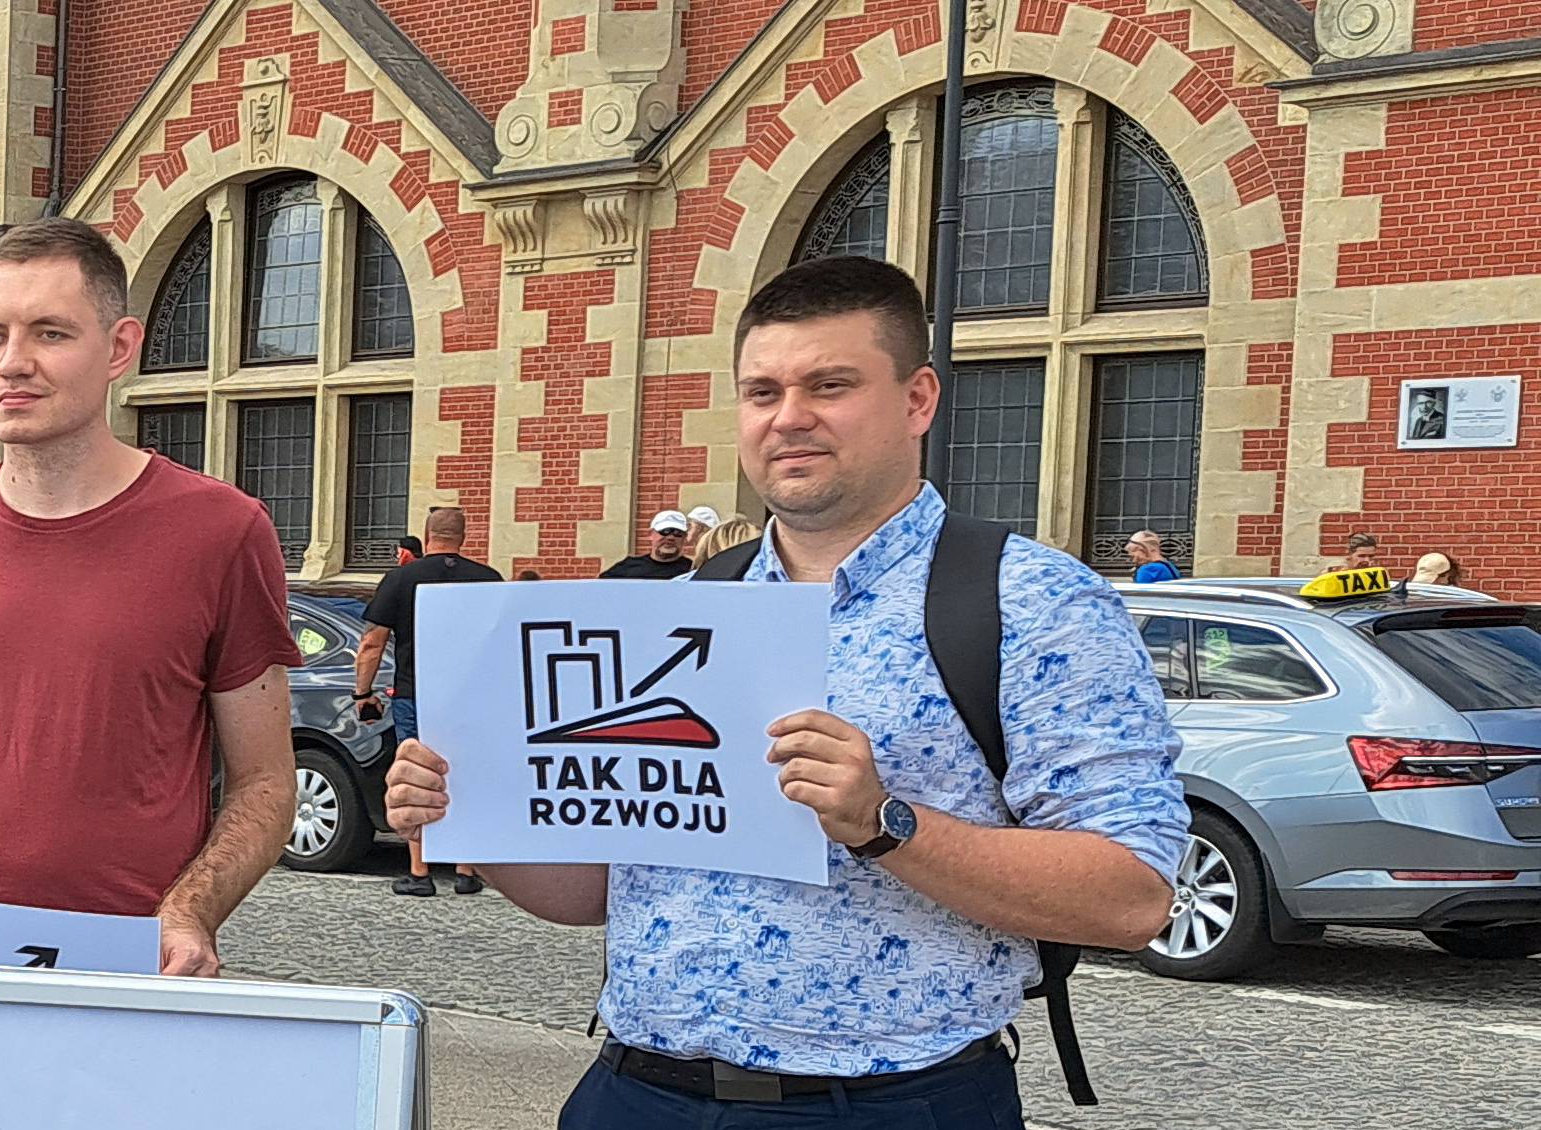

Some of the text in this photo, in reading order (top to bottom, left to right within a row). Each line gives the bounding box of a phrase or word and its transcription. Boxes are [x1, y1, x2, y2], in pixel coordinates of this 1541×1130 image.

[1336, 570, 1389, 593] TAXI
[528, 756, 725, 798] TAK DLA
[529, 798, 727, 833] ROZWOJU
